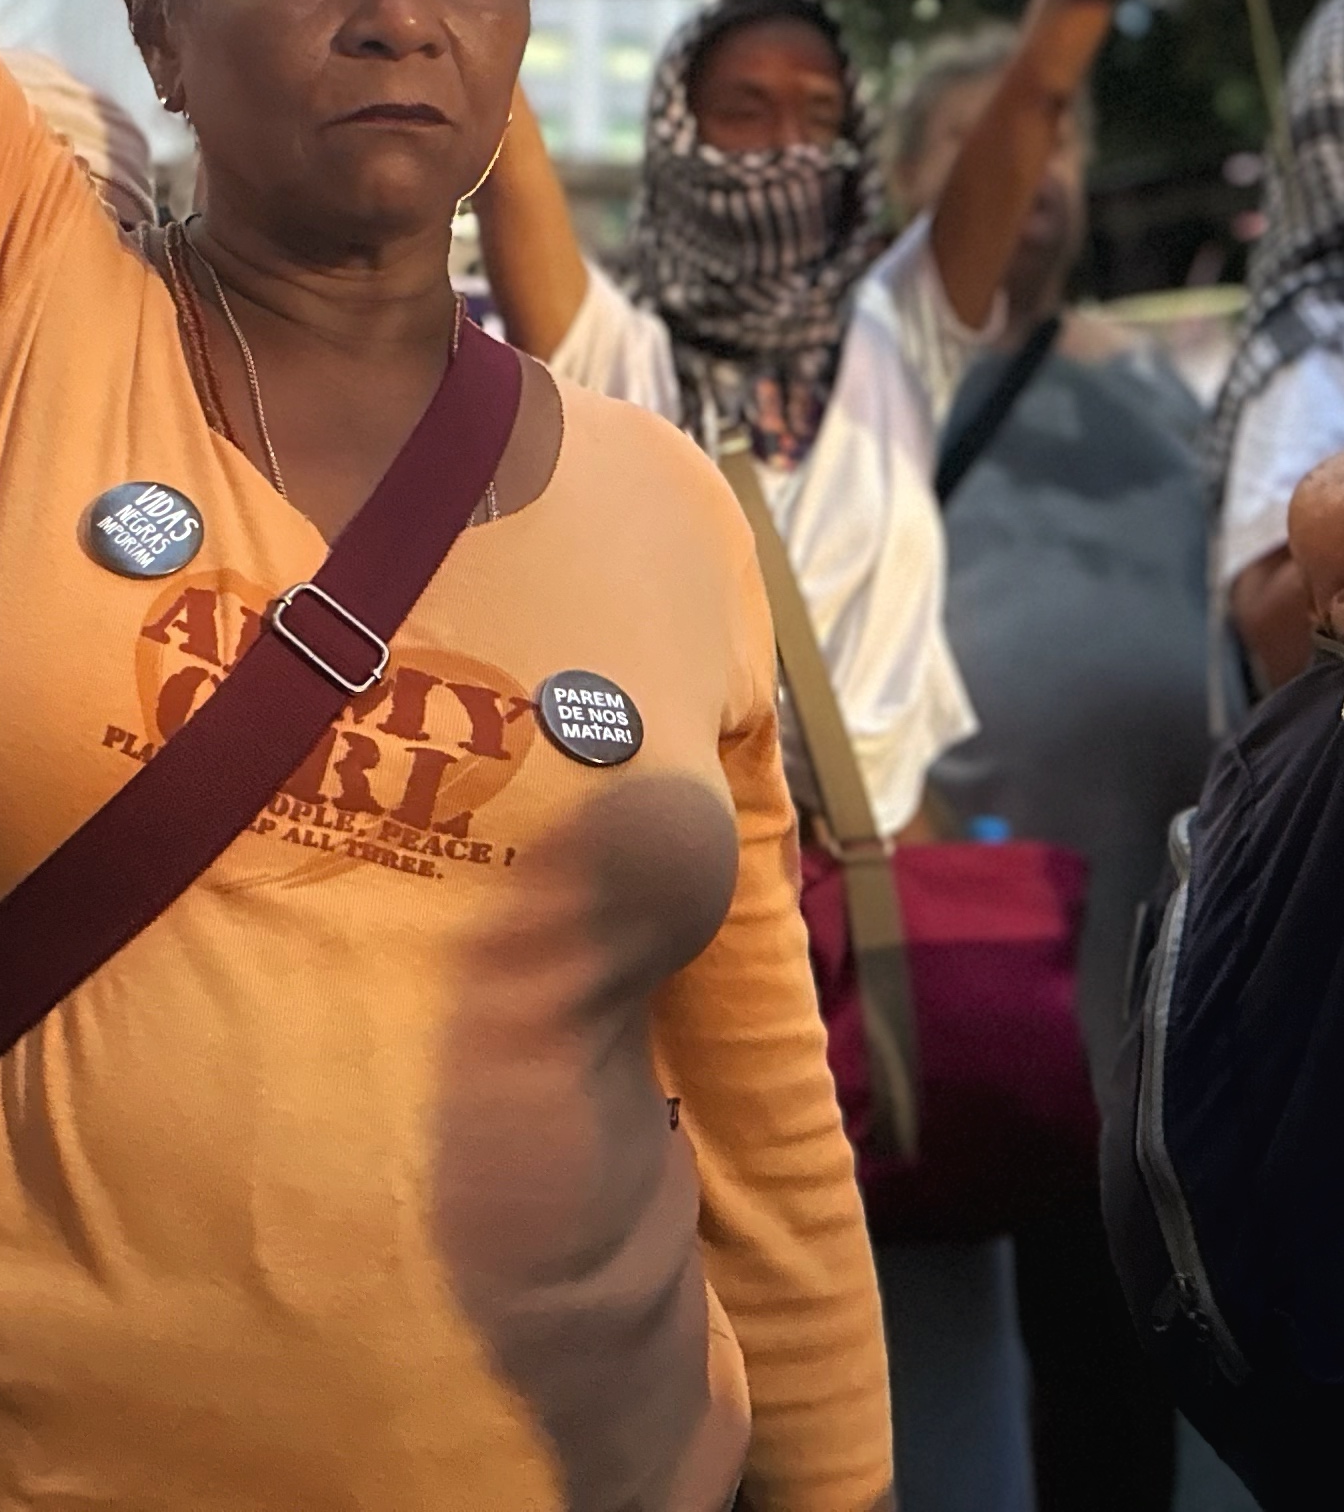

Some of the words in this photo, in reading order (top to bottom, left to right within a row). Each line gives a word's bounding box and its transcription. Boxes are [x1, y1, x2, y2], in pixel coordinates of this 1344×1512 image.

[114, 504, 172, 555] NEGRAS
[135, 484, 200, 542] VIDAS
[96, 515, 156, 569] IMPORTAM
[553, 687, 625, 708] PAREM
[558, 705, 585, 721] DE
[588, 707, 629, 726] NOS
[561, 722, 633, 744] MATAR!
[282, 827, 335, 851] ALL
[342, 838, 445, 879] THREE.
